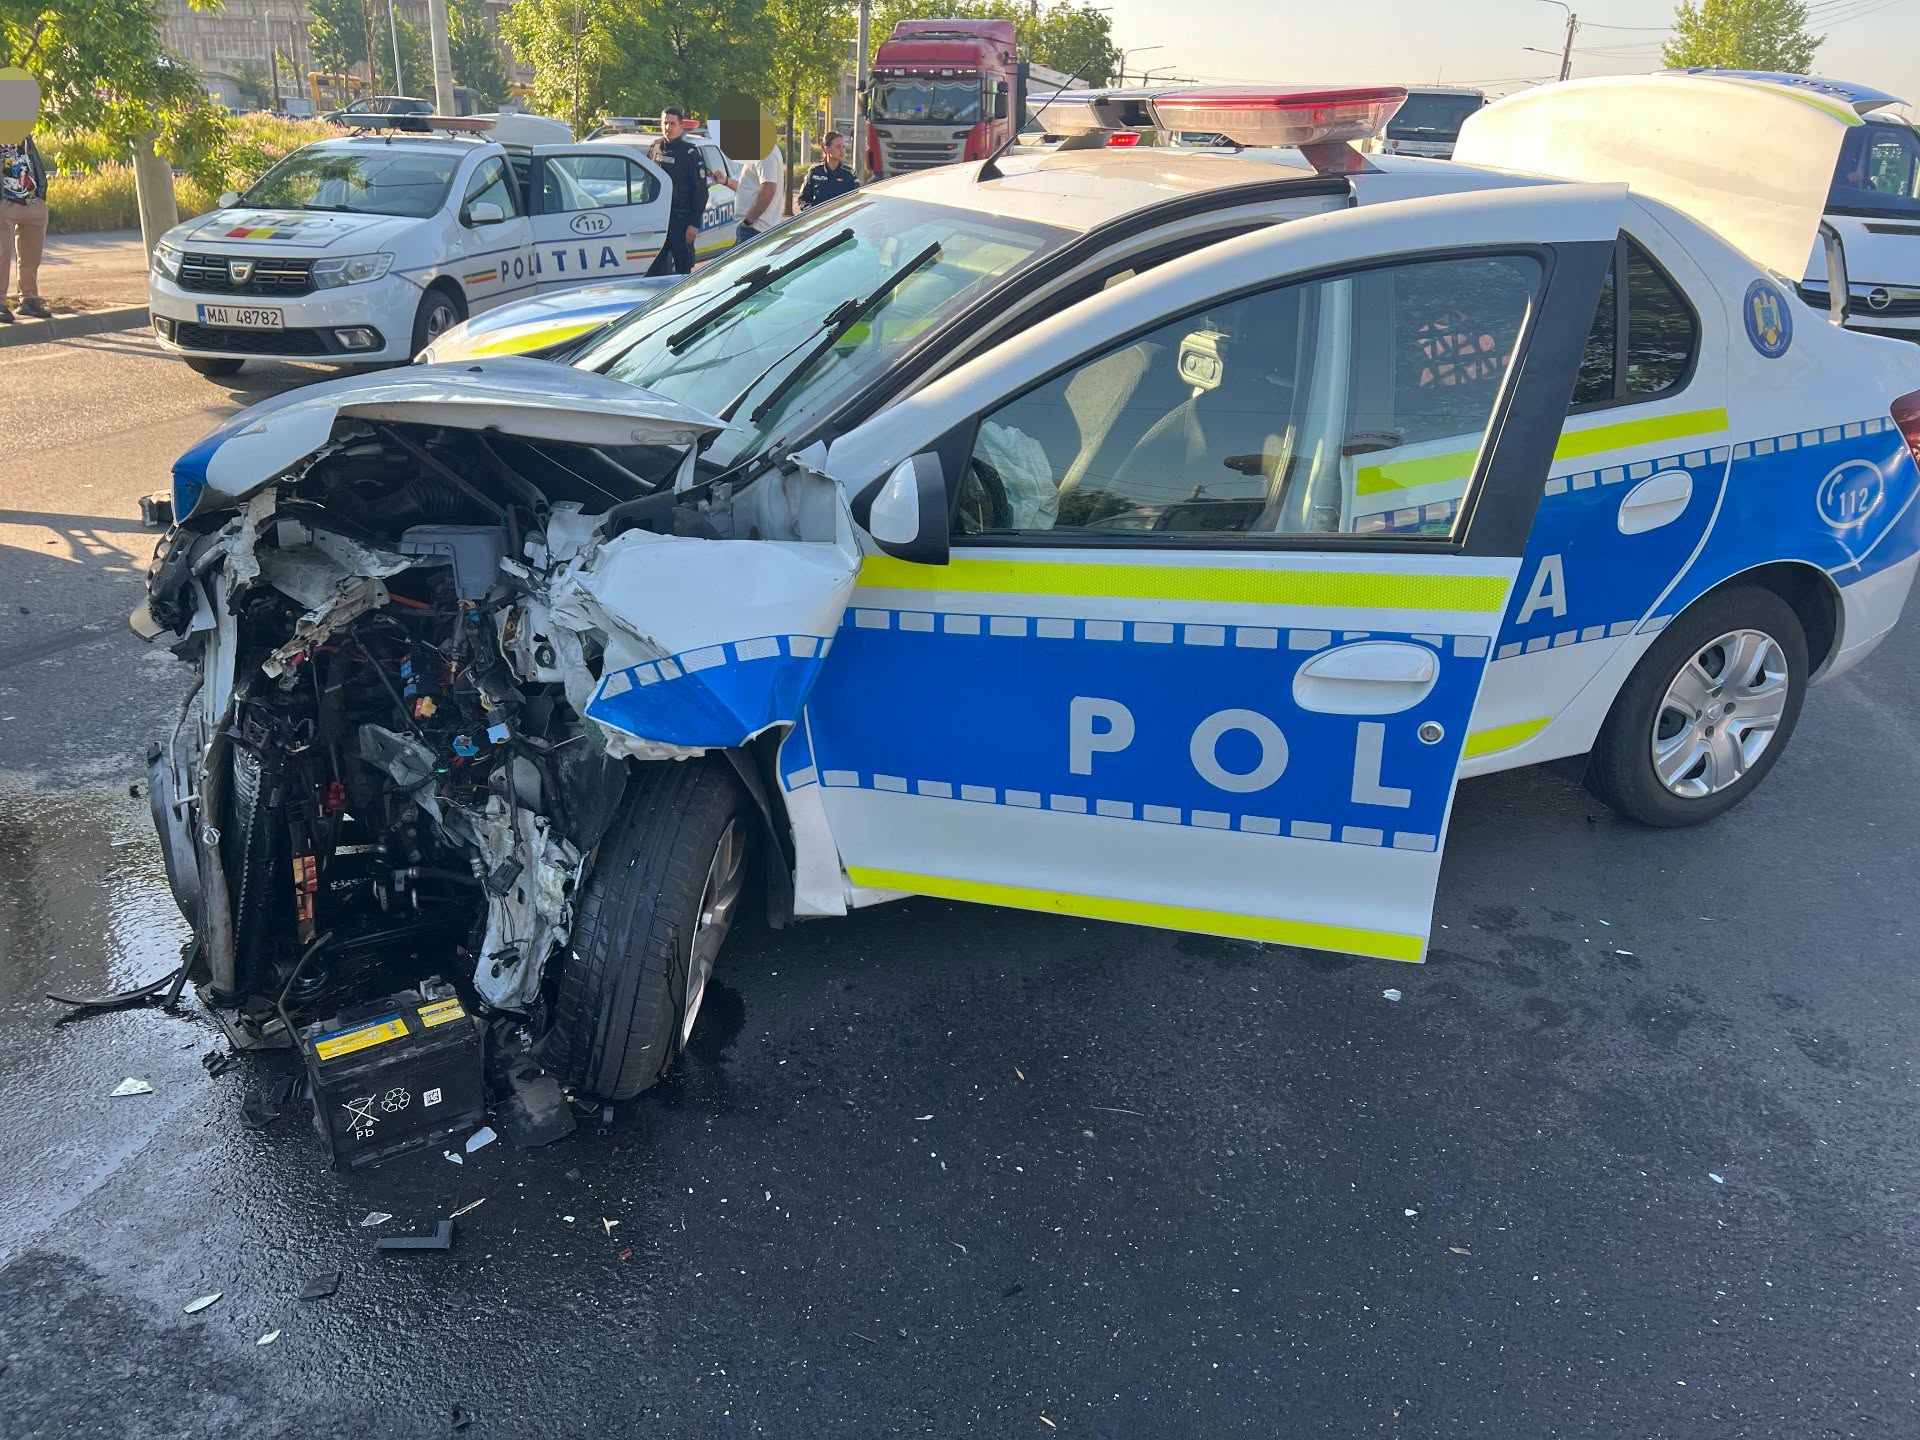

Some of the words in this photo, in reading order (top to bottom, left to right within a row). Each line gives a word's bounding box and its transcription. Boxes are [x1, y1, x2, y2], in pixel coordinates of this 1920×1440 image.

[584, 219, 605, 232] 112
[702, 203, 735, 230] POLITIA
[500, 246, 620, 283] POLITIA
[206, 308, 229, 323] MAI
[236, 310, 280, 326] 48782
[1839, 487, 1869, 517] 112
[356, 1128, 375, 1141] Pb
